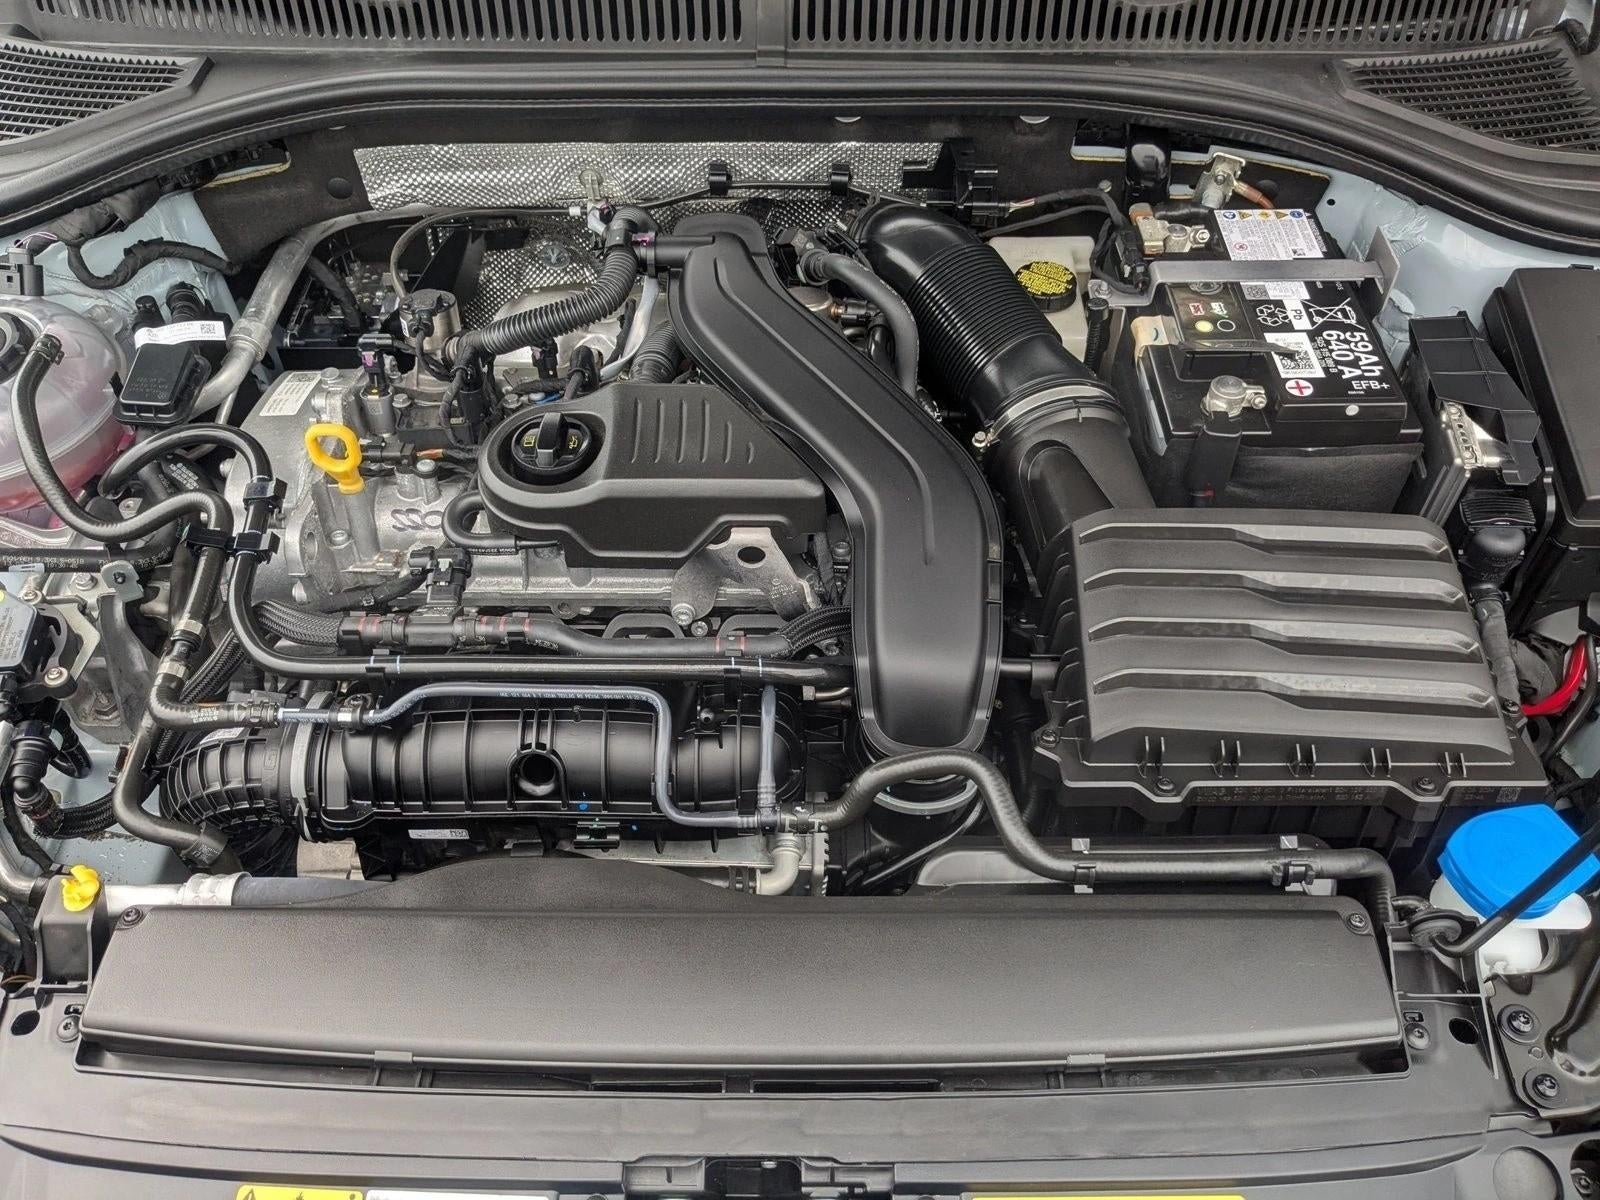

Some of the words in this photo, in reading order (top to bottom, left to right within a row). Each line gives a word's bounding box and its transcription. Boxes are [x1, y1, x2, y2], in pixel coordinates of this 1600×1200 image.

[1291, 308, 1303, 320] Pb
[1322, 330, 1355, 361] 640
[1345, 331, 1384, 377] 59Ah
[1337, 364, 1363, 379] A
[1351, 380, 1390, 390] EFB+
